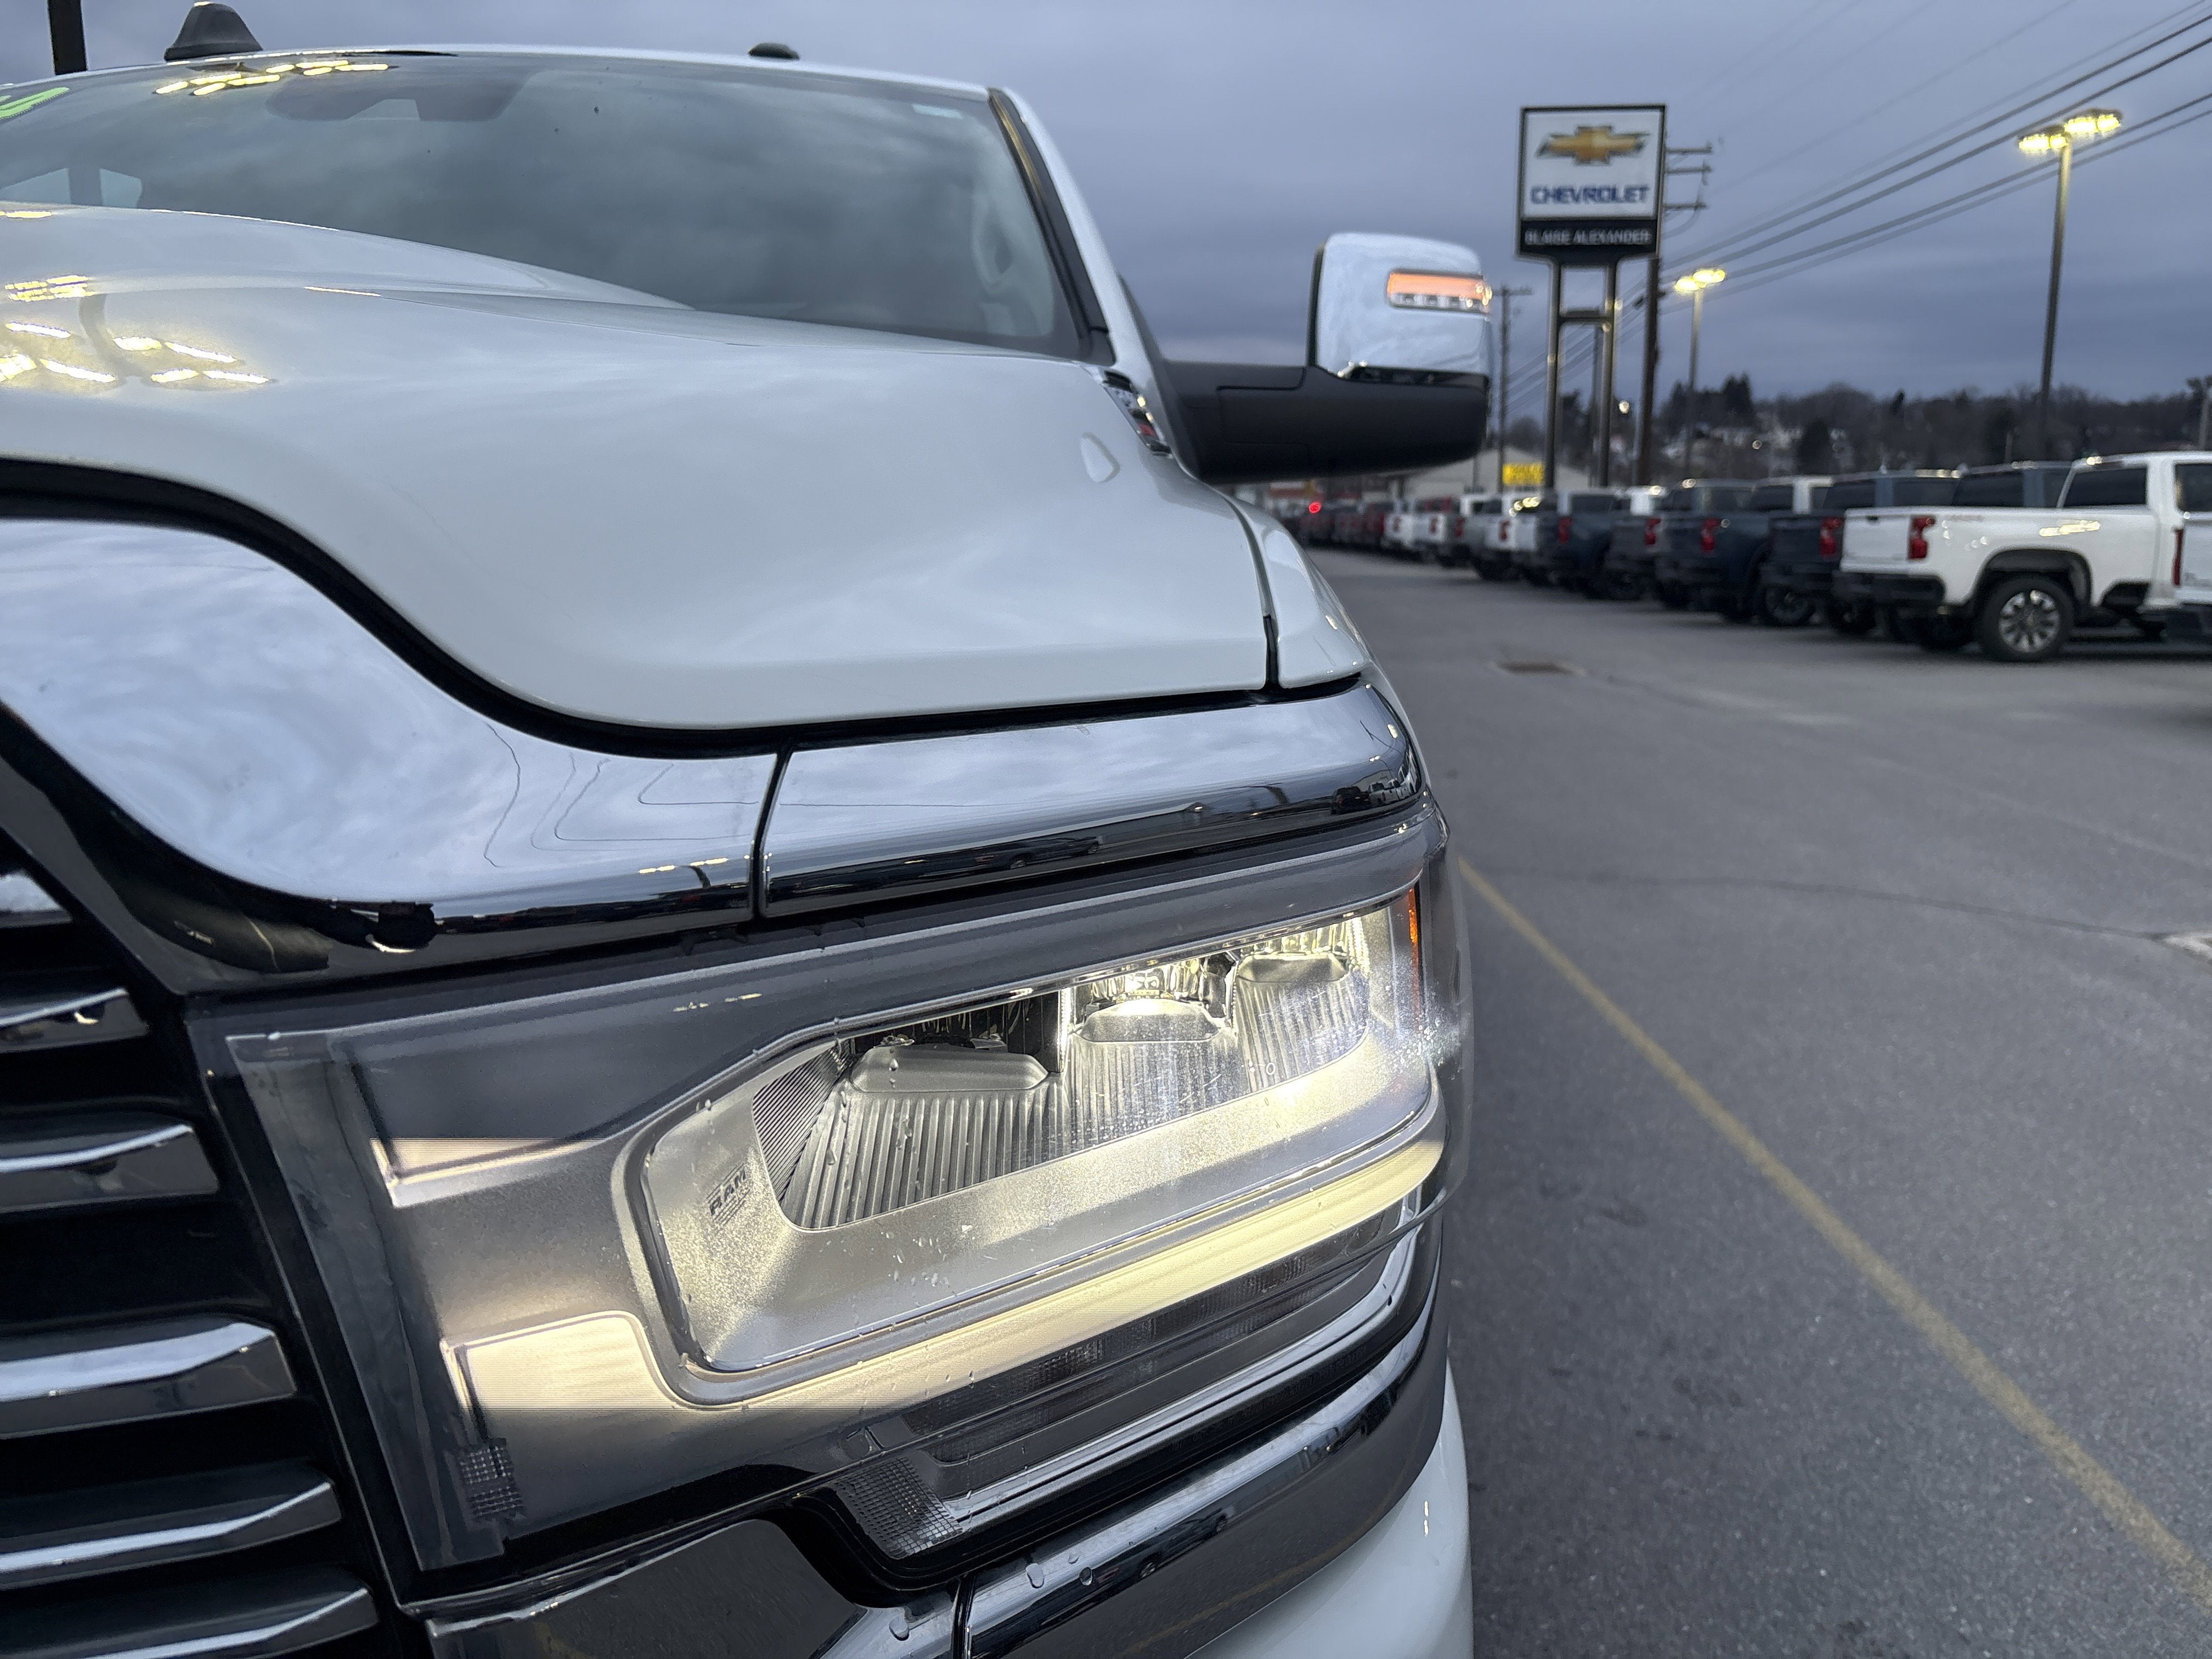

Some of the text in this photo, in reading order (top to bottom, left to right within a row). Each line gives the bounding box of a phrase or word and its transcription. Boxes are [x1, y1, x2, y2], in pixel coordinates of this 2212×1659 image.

[1530, 185, 1649, 204] CHEVROLET
[1573, 228, 1651, 245] ALEXANDER
[709, 1167, 746, 1216] RAM
